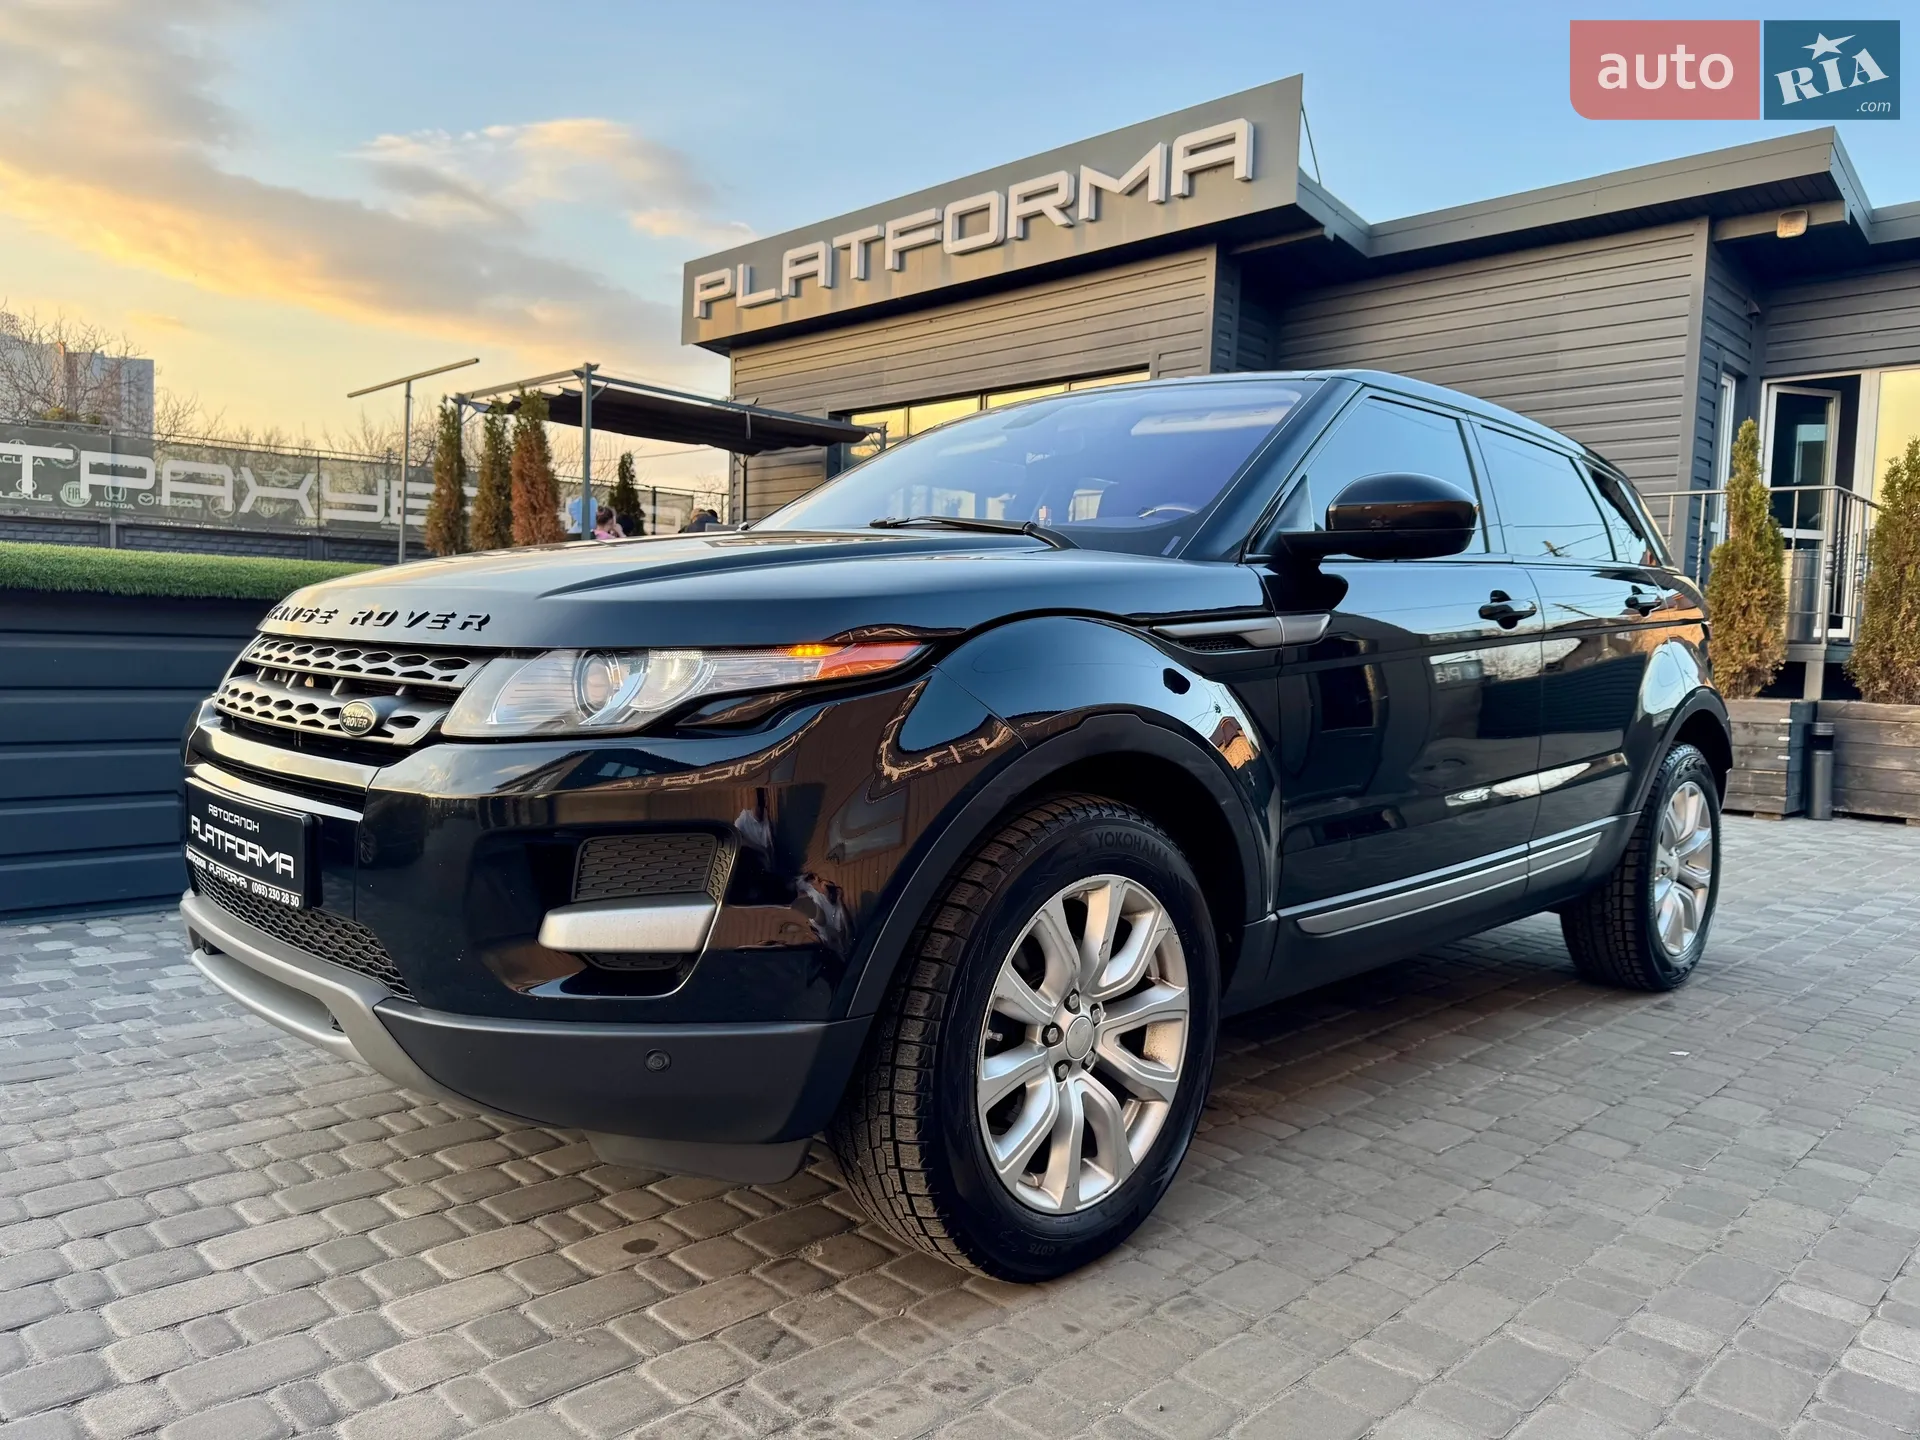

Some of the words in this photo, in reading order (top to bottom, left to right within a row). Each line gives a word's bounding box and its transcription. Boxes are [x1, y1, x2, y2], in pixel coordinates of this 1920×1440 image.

[693, 117, 1254, 320] PLATFORMA
[0, 454, 45, 467] CUA
[95, 500, 136, 510] HONDA
[294, 518, 328, 528] TOYOA
[349, 609, 491, 632] ROVER
[345, 717, 368, 728] ROVER
[191, 815, 294, 879] PLATFORMA
